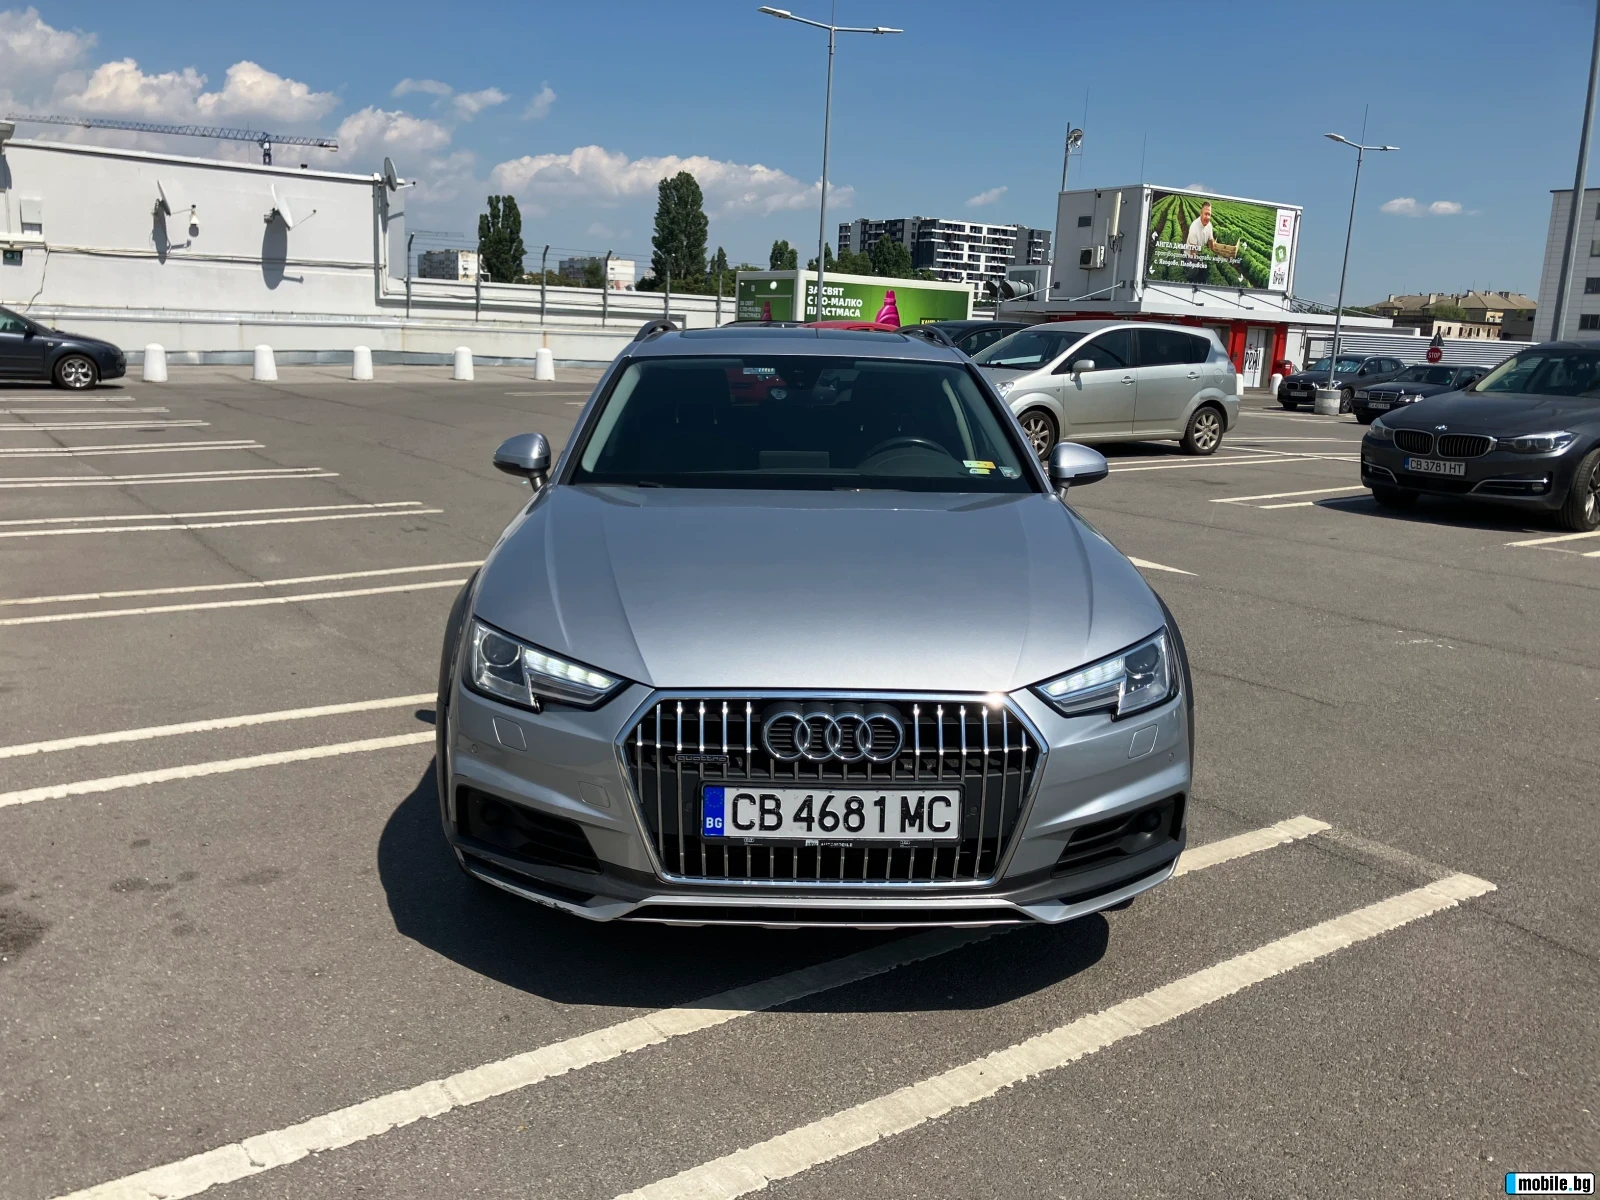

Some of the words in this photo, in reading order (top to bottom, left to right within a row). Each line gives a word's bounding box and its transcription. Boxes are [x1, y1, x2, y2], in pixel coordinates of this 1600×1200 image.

[821, 286, 845, 296] СВЯТ
[807, 296, 814, 305] С
[1427, 351, 1441, 359] STOP
[1410, 459, 1422, 470] CB
[1423, 460, 1447, 473] 3781
[1449, 462, 1463, 474] HT
[732, 792, 783, 832] CB
[793, 793, 886, 833] 4681
[900, 794, 952, 833] MC
[706, 817, 722, 829] BG
